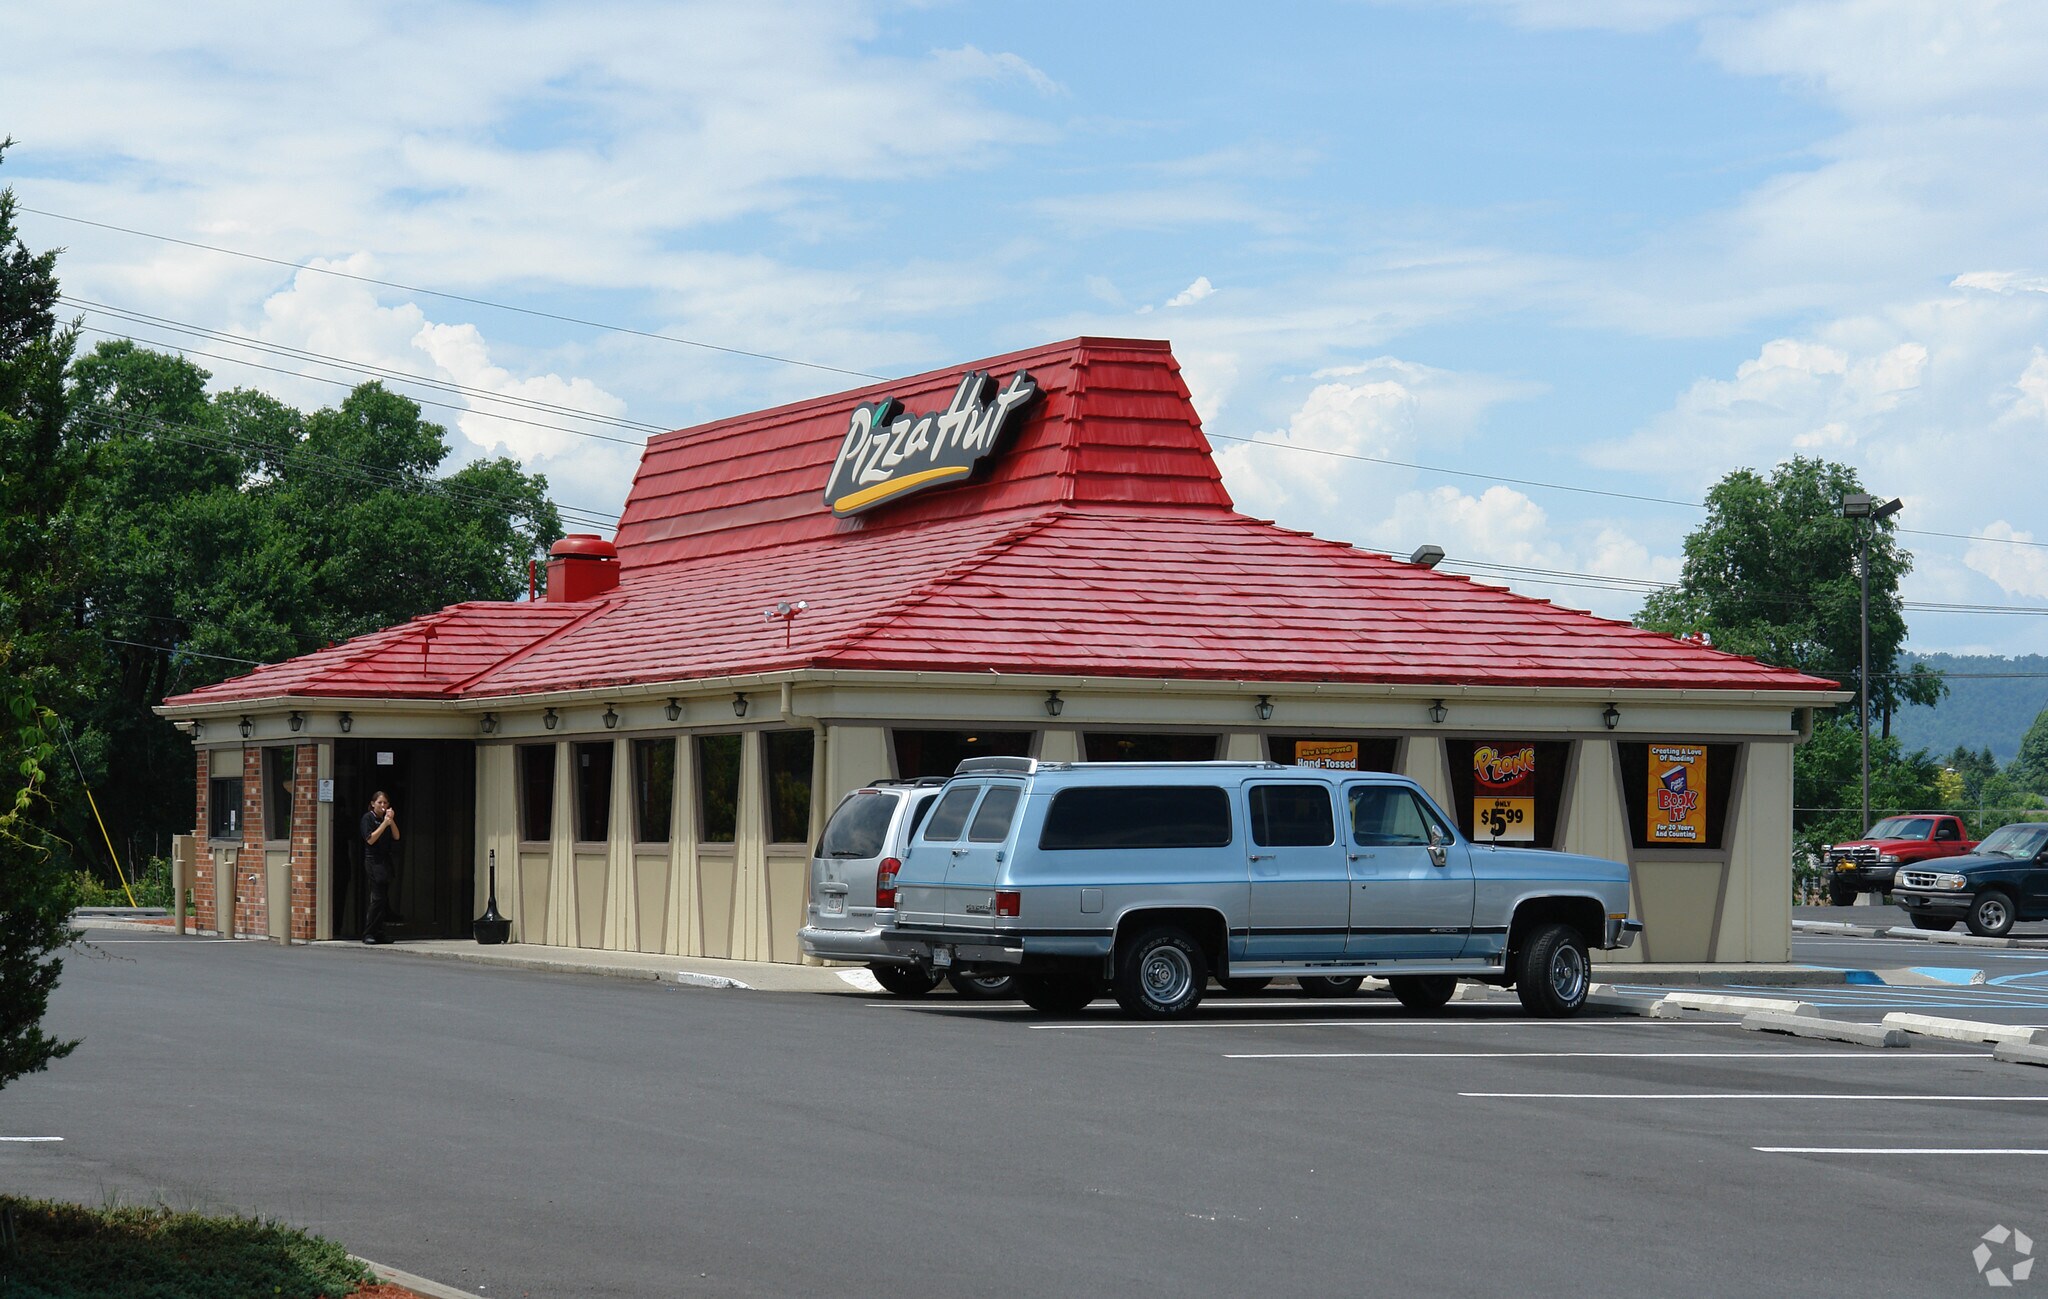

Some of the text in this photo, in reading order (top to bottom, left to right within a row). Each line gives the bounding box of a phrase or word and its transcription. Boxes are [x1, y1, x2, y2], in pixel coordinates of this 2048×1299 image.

[824, 375, 1031, 499] Pizza Hut
[1652, 747, 1680, 756] Creating
[1687, 748, 1702, 756] Love
[1660, 754, 1695, 763] Of Reading
[1297, 758, 1356, 769] Hand-Tossed
[1677, 824, 1694, 832] Years
[1668, 831, 1696, 839] Counting
